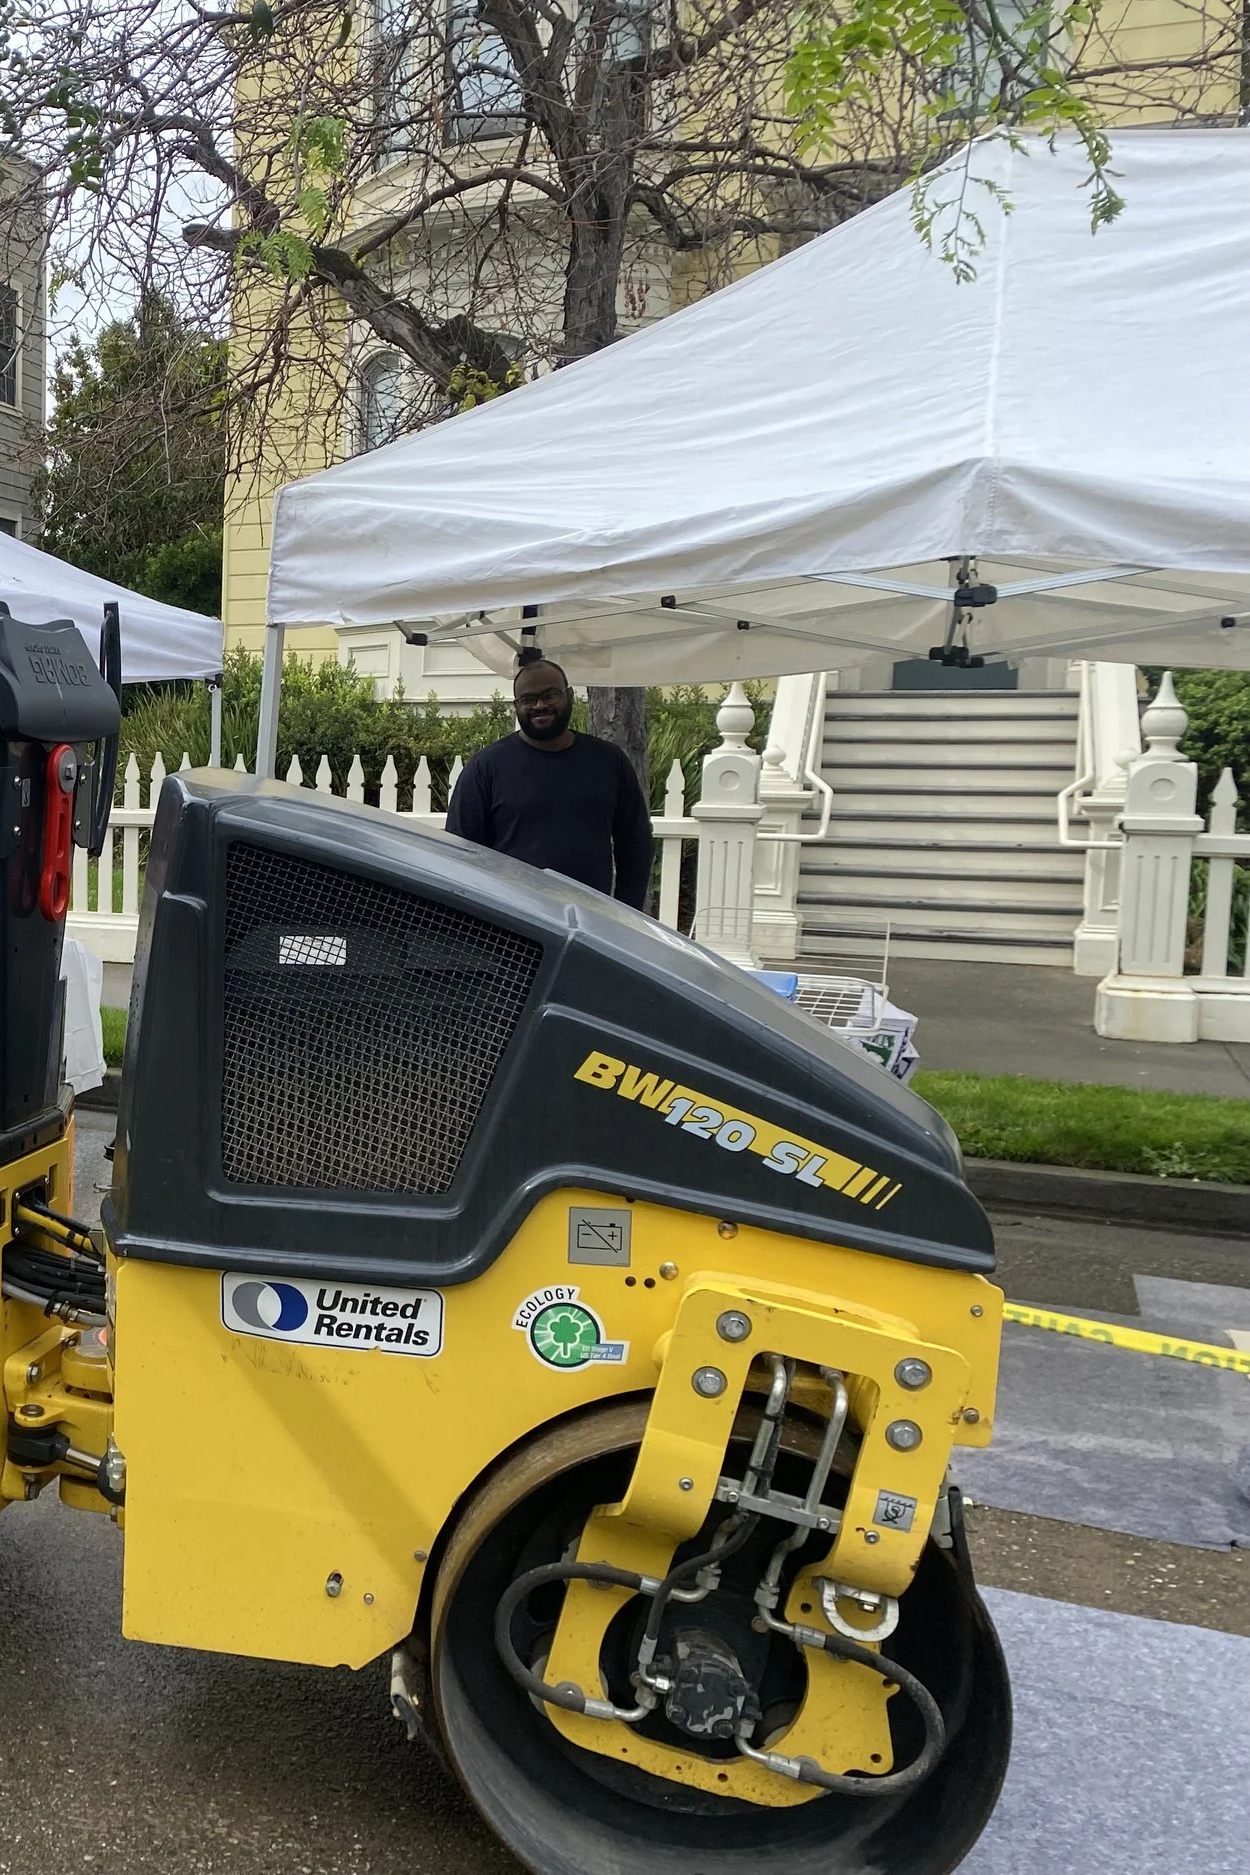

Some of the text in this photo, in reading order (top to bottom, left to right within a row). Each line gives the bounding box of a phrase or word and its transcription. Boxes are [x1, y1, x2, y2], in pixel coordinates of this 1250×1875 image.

[762, 1140, 829, 1188] SL
[316, 1288, 423, 1320] United
[515, 1287, 576, 1329] ECOLOGY
[313, 1314, 431, 1347] Rentals
